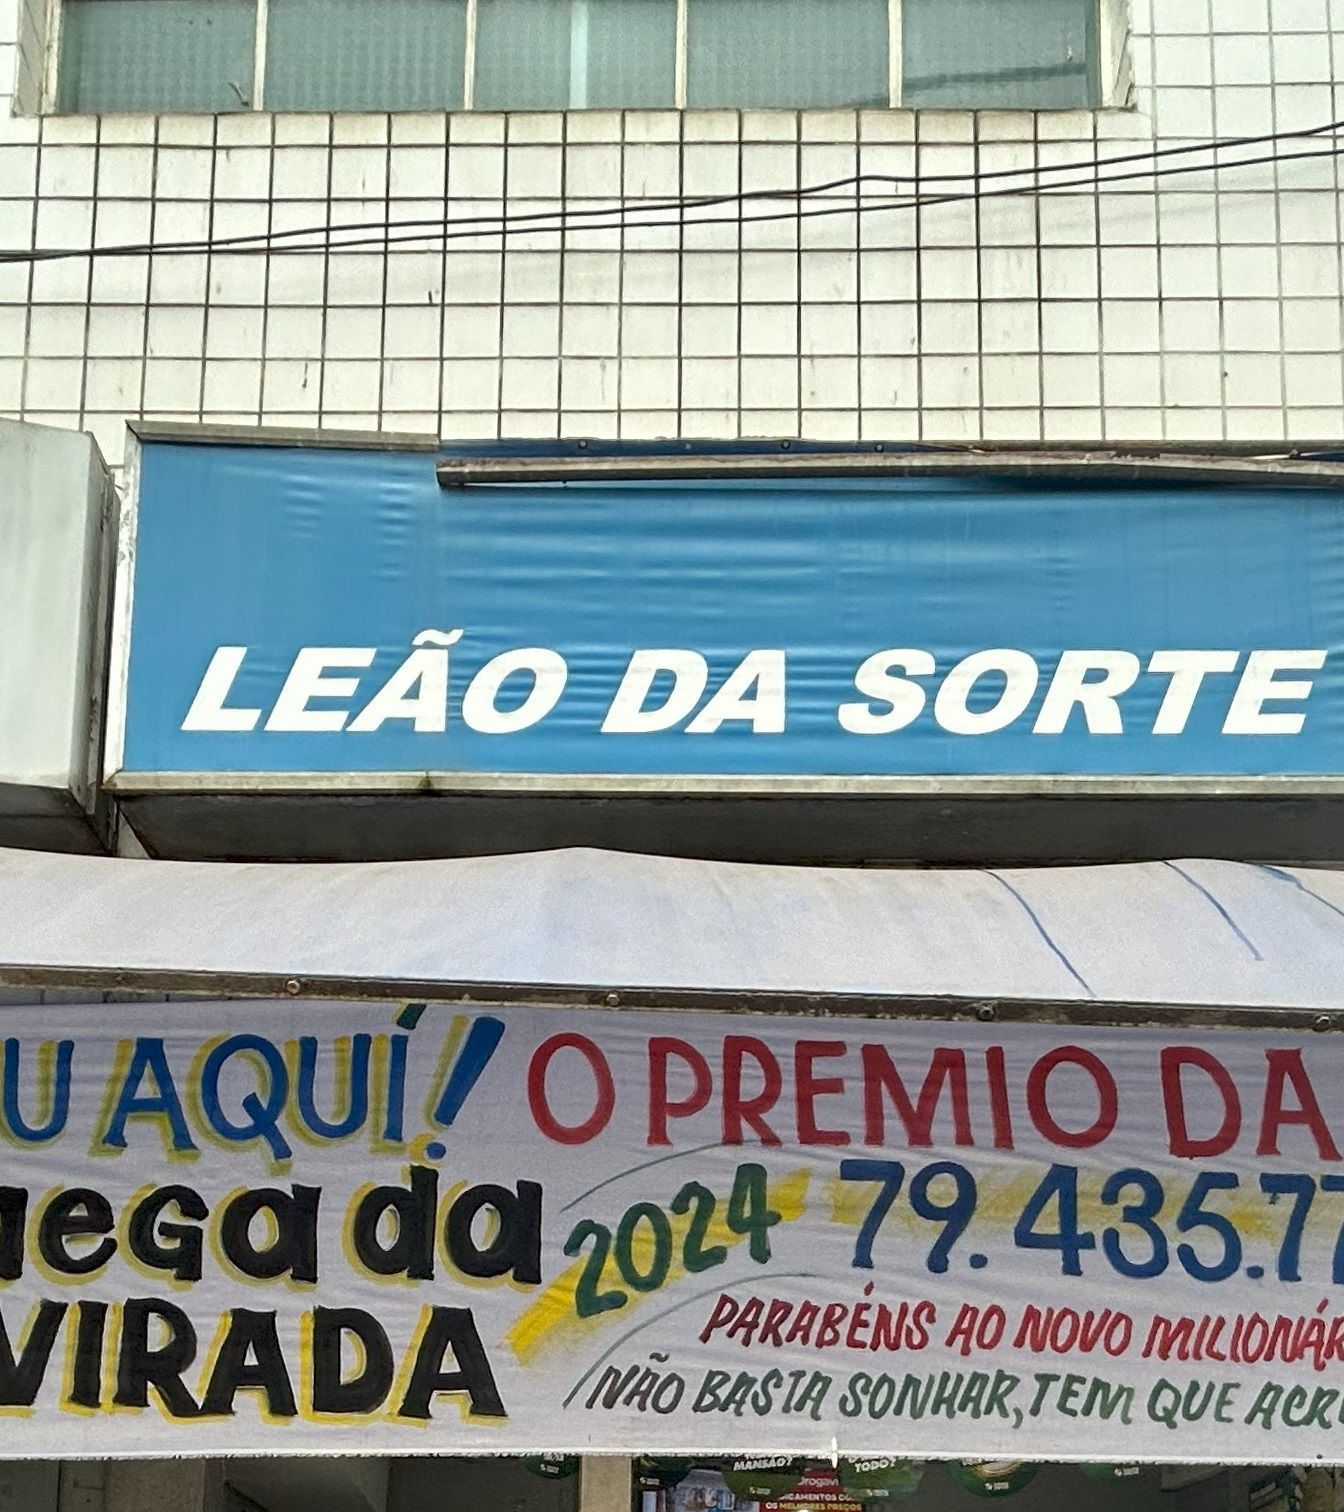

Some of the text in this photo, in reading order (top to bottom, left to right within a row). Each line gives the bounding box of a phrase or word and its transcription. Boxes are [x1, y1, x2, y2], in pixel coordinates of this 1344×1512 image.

[180, 629, 1328, 736] LEÃO DA SORTE
[527, 1032, 616, 1145] O
[646, 1034, 1119, 1150] PREMIO
[1160, 1045, 1344, 1162] DA
[344, 1164, 543, 1293] da
[563, 1162, 783, 1319] 2024
[699, 1282, 936, 1353] PARABÉNS
[945, 1304, 1007, 1356] AO
[1013, 1304, 1134, 1358] NOVO
[585, 1352, 686, 1414] NÃO
[692, 1367, 832, 1417] BASTA
[1029, 1371, 1135, 1425] TEM
[1146, 1376, 1241, 1430] QUE
